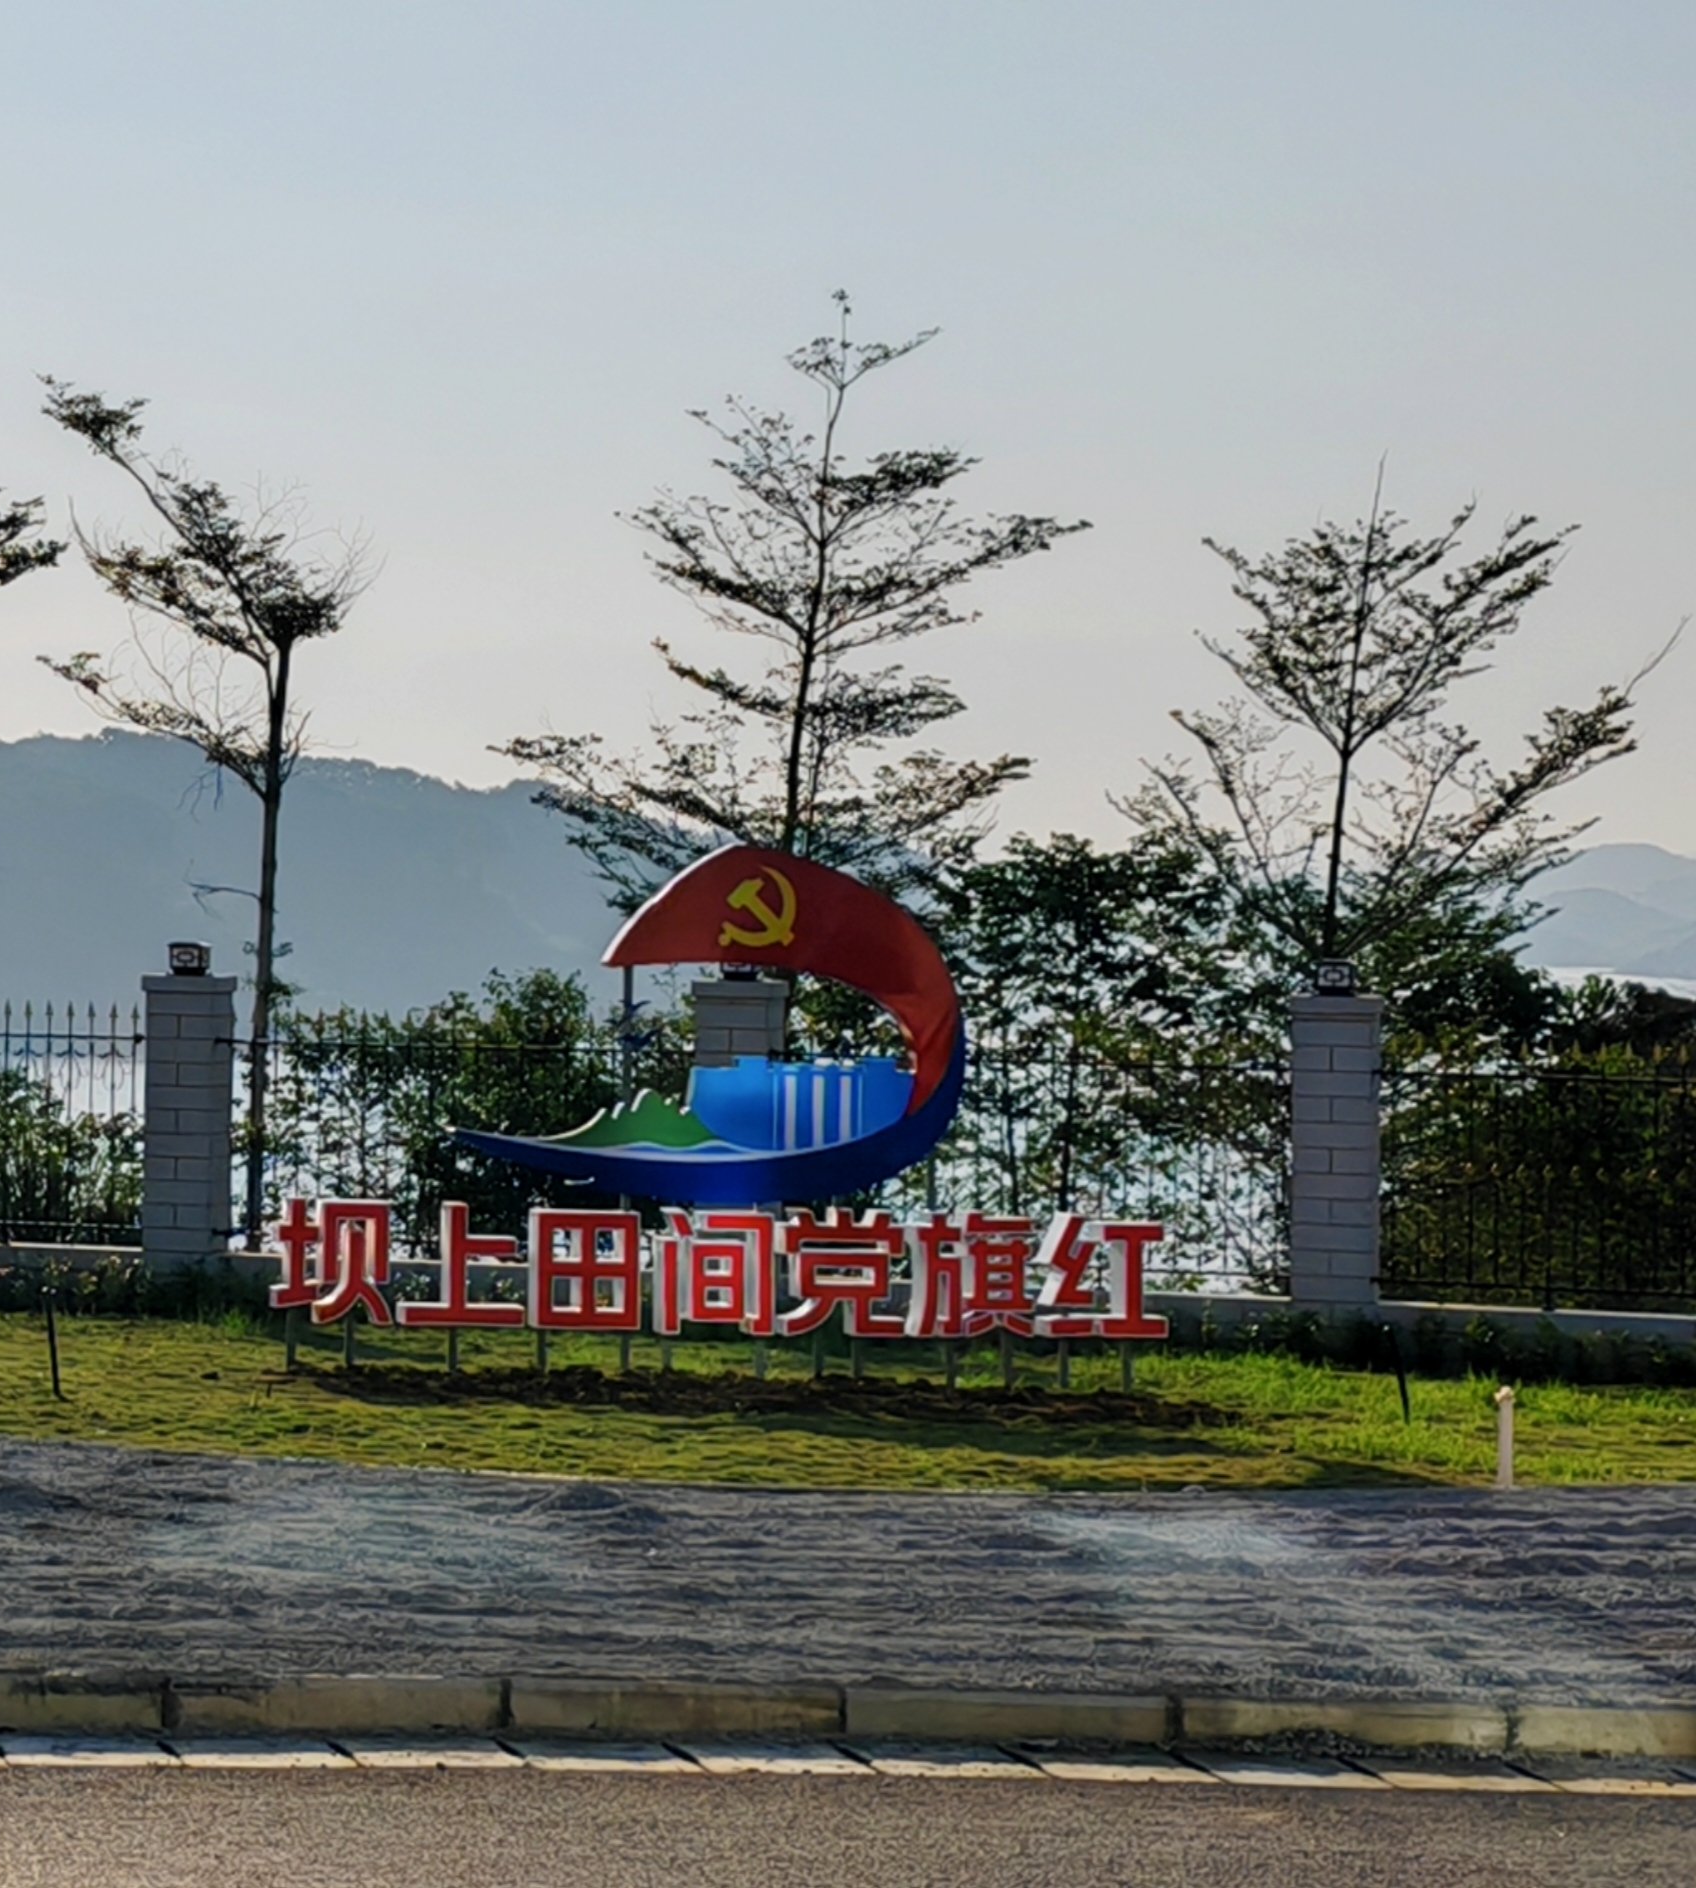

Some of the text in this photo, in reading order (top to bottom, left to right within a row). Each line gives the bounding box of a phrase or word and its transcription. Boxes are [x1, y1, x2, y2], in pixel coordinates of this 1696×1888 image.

[269, 1199, 1170, 1339] 坝上田间党旗红
